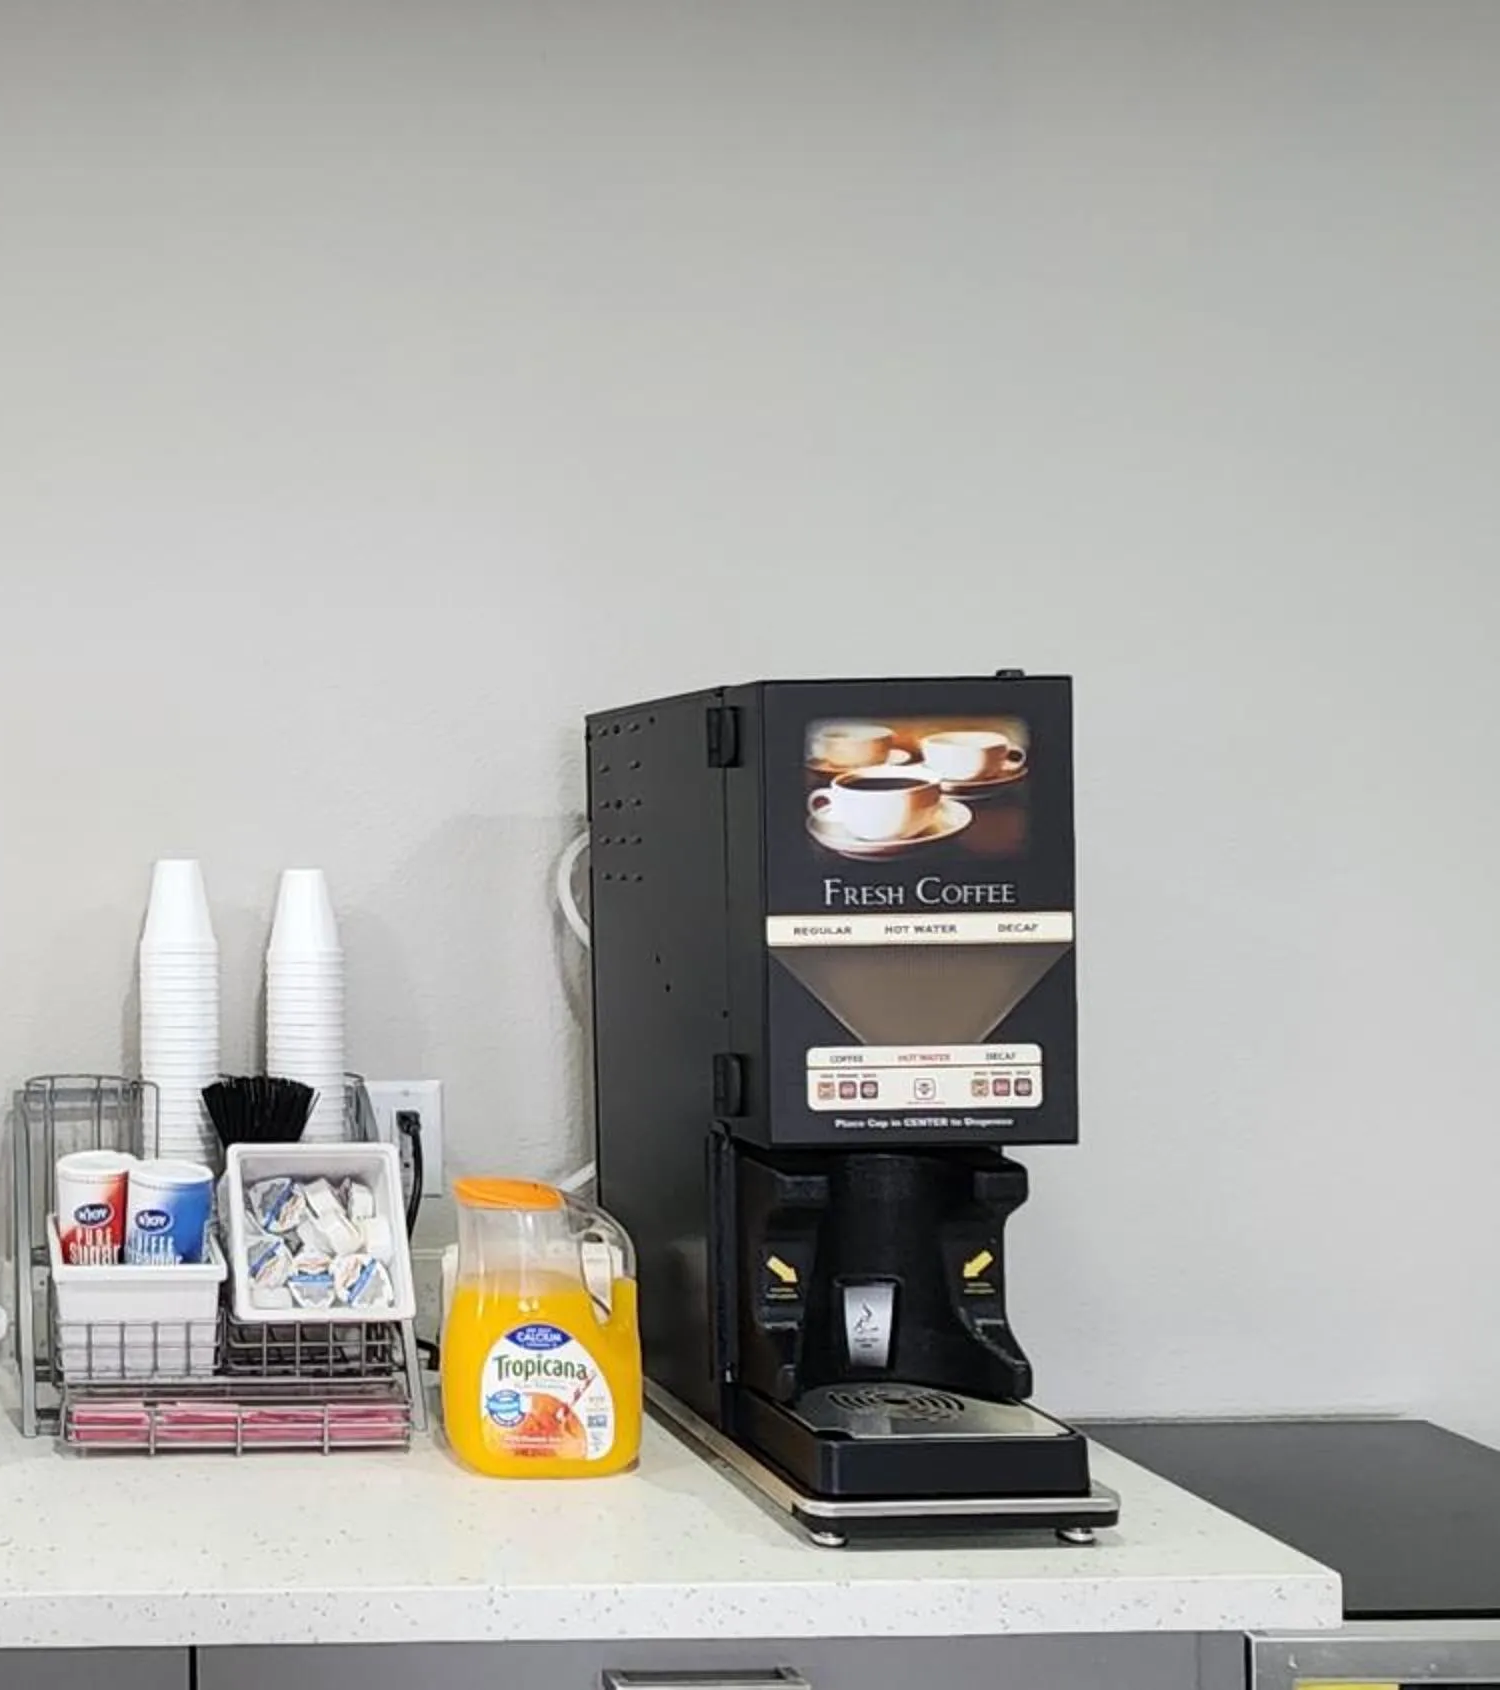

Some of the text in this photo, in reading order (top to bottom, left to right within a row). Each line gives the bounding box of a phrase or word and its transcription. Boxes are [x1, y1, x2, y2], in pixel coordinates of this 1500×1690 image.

[823, 877, 1017, 905] FRESH COFFEE
[793, 926, 852, 936] REGULAR
[885, 924, 957, 934] HOT WATER
[997, 923, 1039, 933] DECAF
[985, 1051, 1016, 1061] DECAF
[904, 1117, 949, 1128] CENTER
[75, 1228, 113, 1246] PURE
[493, 1353, 588, 1381] Tropicana
